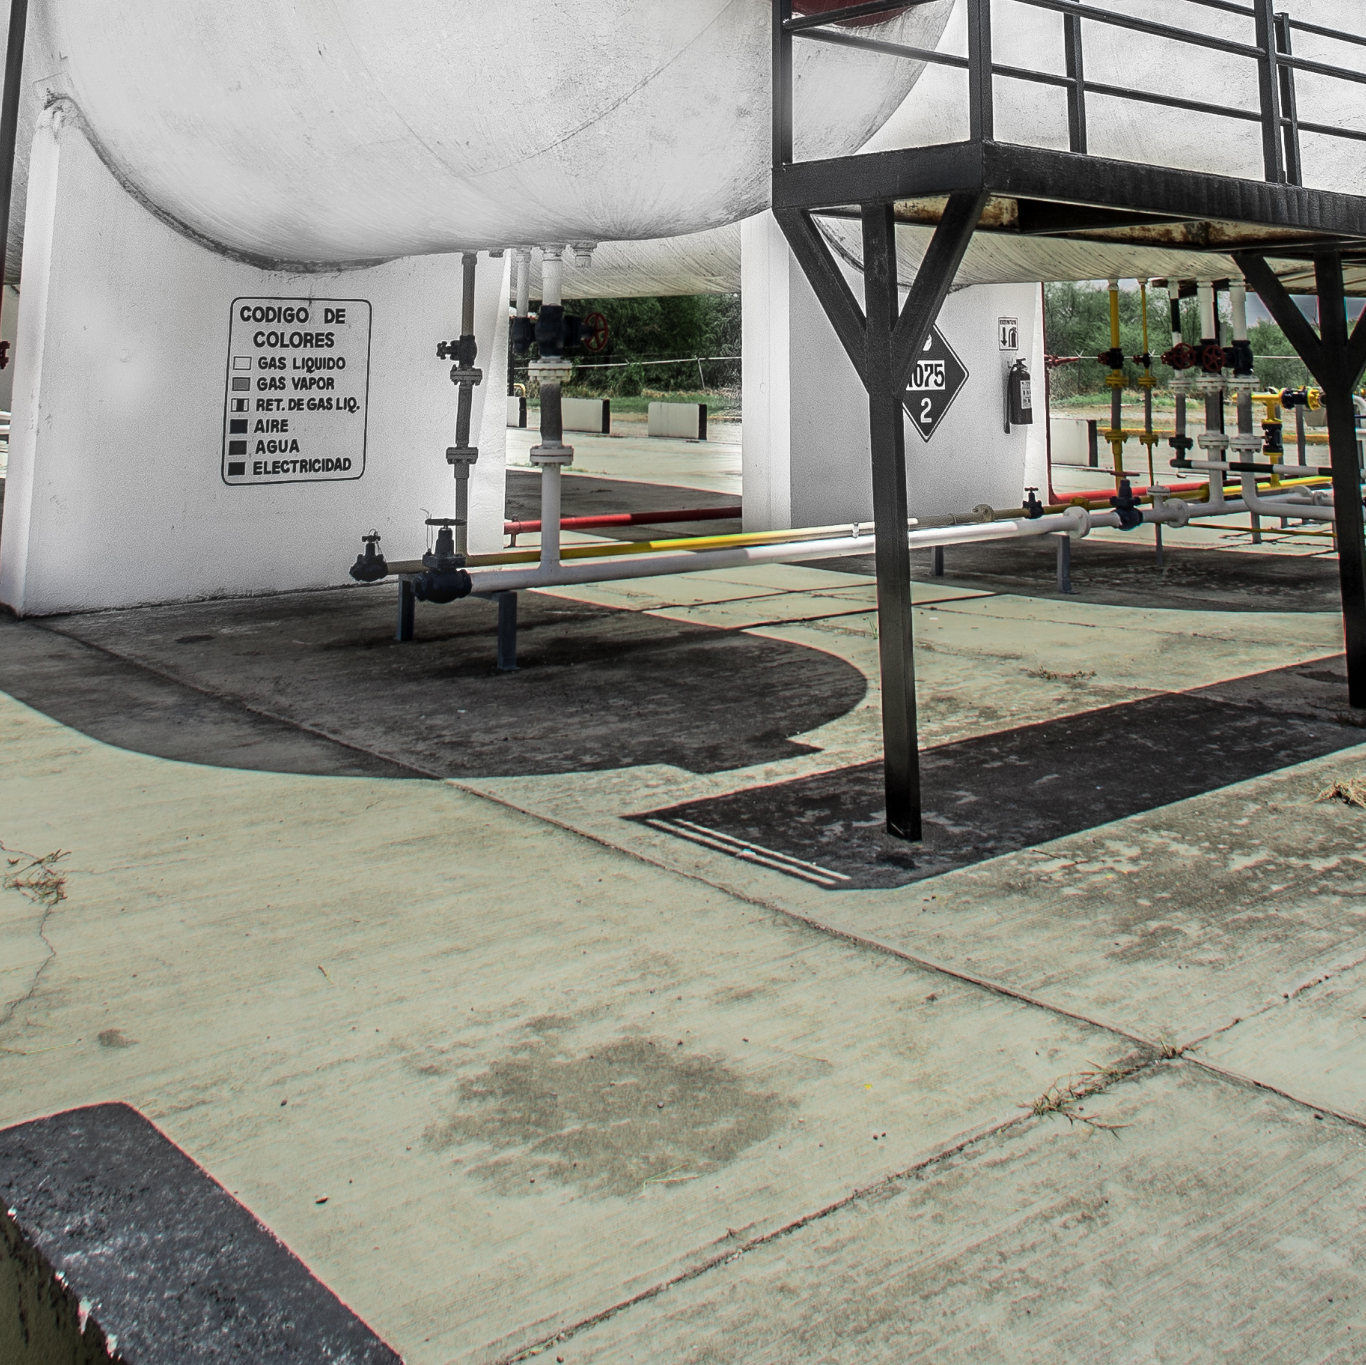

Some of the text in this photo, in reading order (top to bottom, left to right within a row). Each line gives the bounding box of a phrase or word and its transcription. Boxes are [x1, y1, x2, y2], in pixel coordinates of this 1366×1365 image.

[240, 306, 346, 324] CODIGO DE
[253, 331, 335, 348] COLORES
[258, 356, 346, 374] GAS LIQUIDO
[257, 376, 335, 391] GAS VAPOR
[256, 397, 360, 413] RET. DE GAS LIQ.
[920, 397, 933, 424] 2
[254, 419, 289, 433] AIRE
[255, 439, 300, 454] AGUA
[253, 457, 352, 475] ELECTRICIDAD
